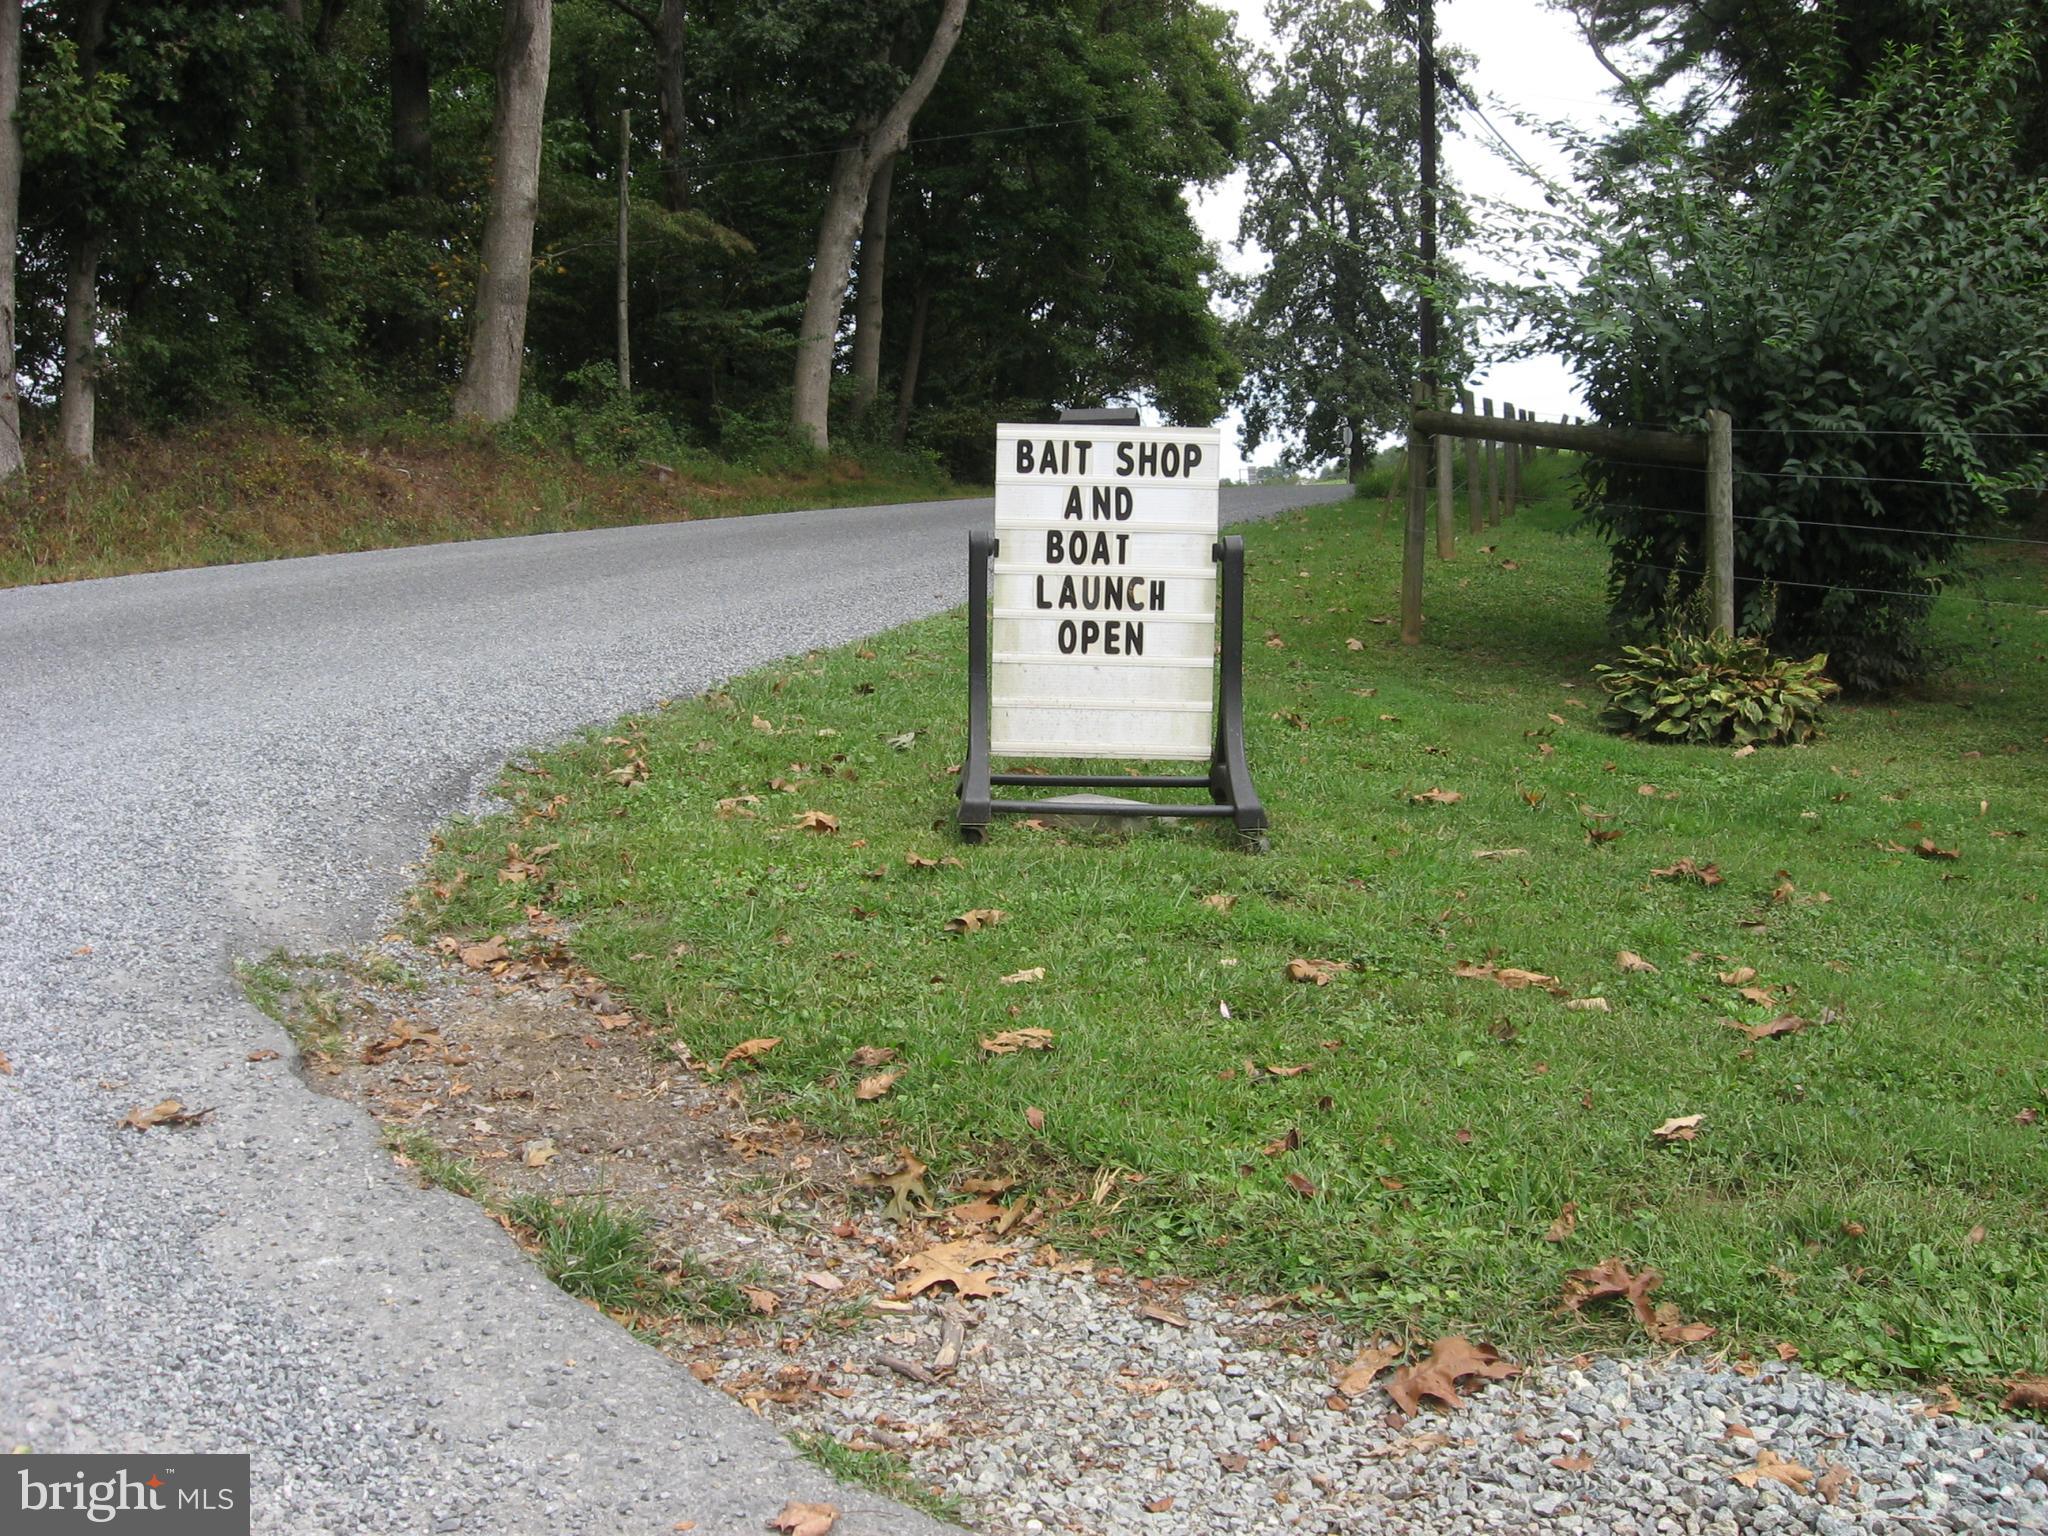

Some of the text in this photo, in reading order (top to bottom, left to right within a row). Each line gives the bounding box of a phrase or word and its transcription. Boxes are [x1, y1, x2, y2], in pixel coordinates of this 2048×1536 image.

[1016, 439, 1202, 478] BAIT SHOP
[1064, 485, 1133, 521] AND
[1046, 530, 1129, 565] BOAT
[1037, 575, 1165, 611] LAUNCH
[1058, 620, 1144, 656] OPEN
